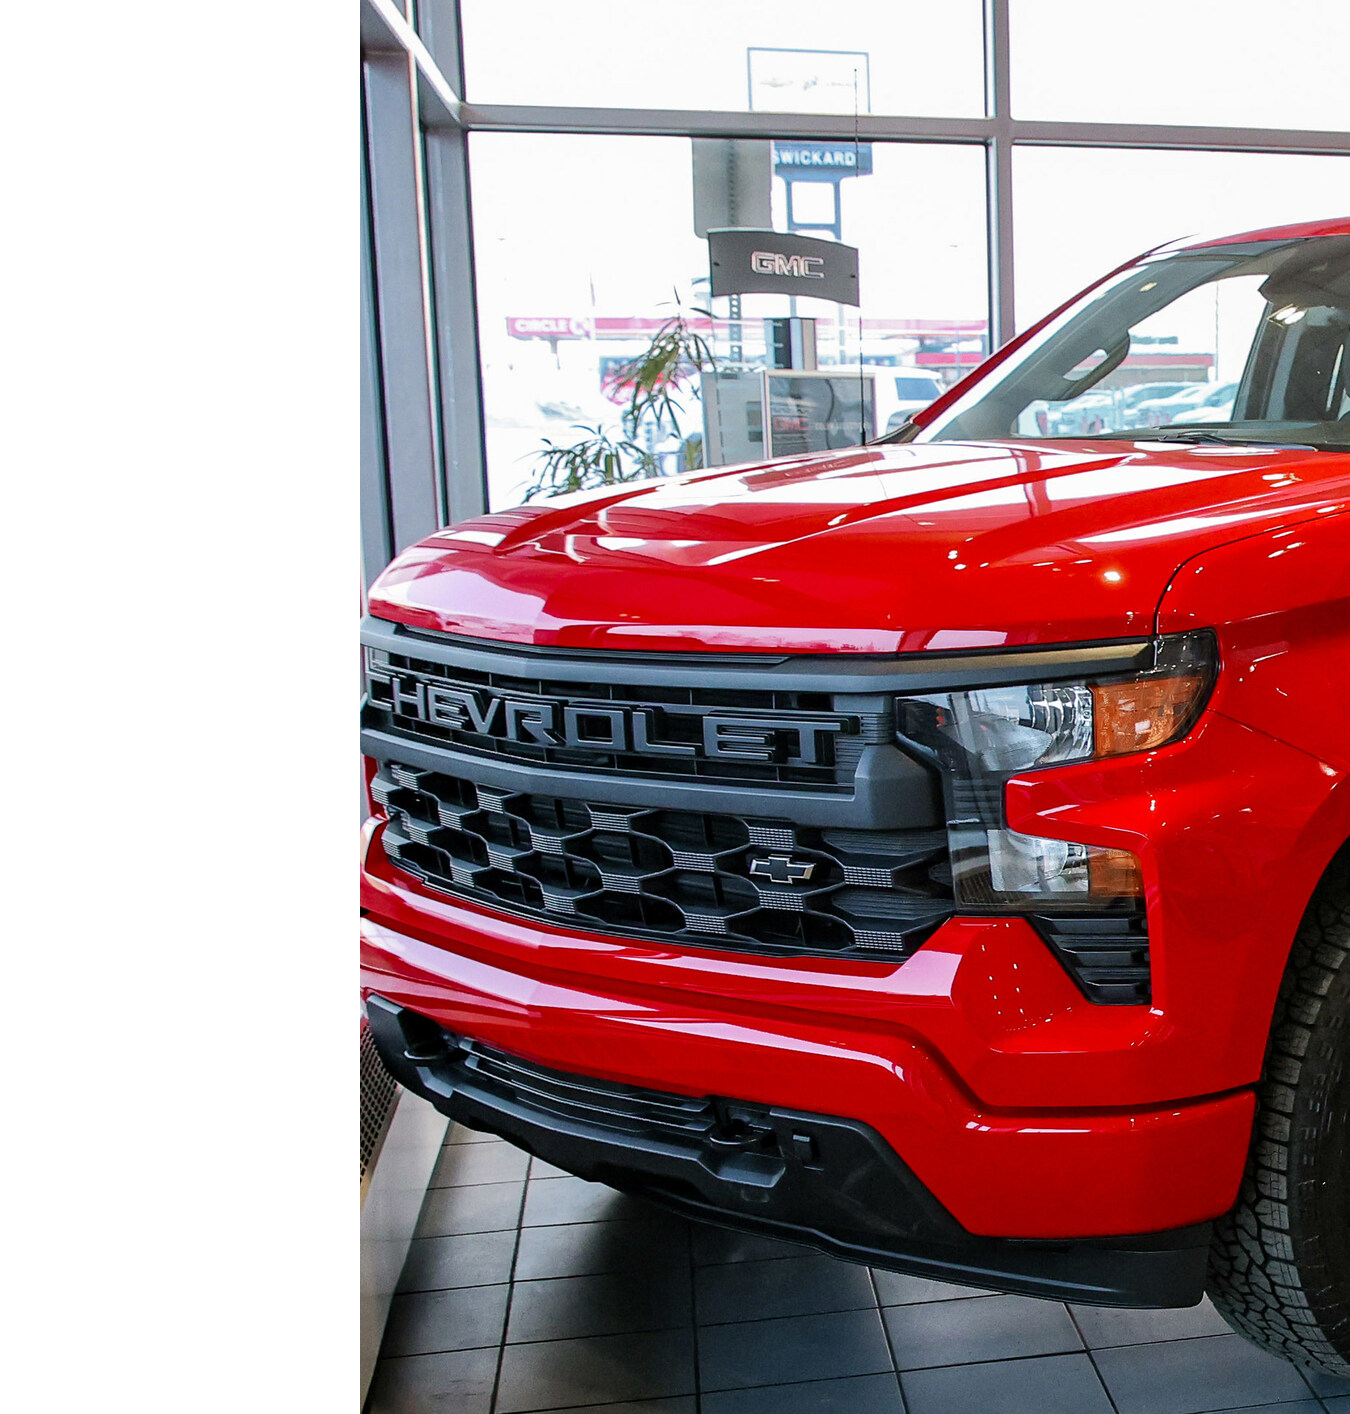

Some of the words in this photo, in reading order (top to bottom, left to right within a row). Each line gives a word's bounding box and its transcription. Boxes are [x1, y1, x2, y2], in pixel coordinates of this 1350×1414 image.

[774, 149, 857, 167] SWICKARD
[751, 251, 825, 279] GMC
[363, 668, 844, 765] CHEVROLET
